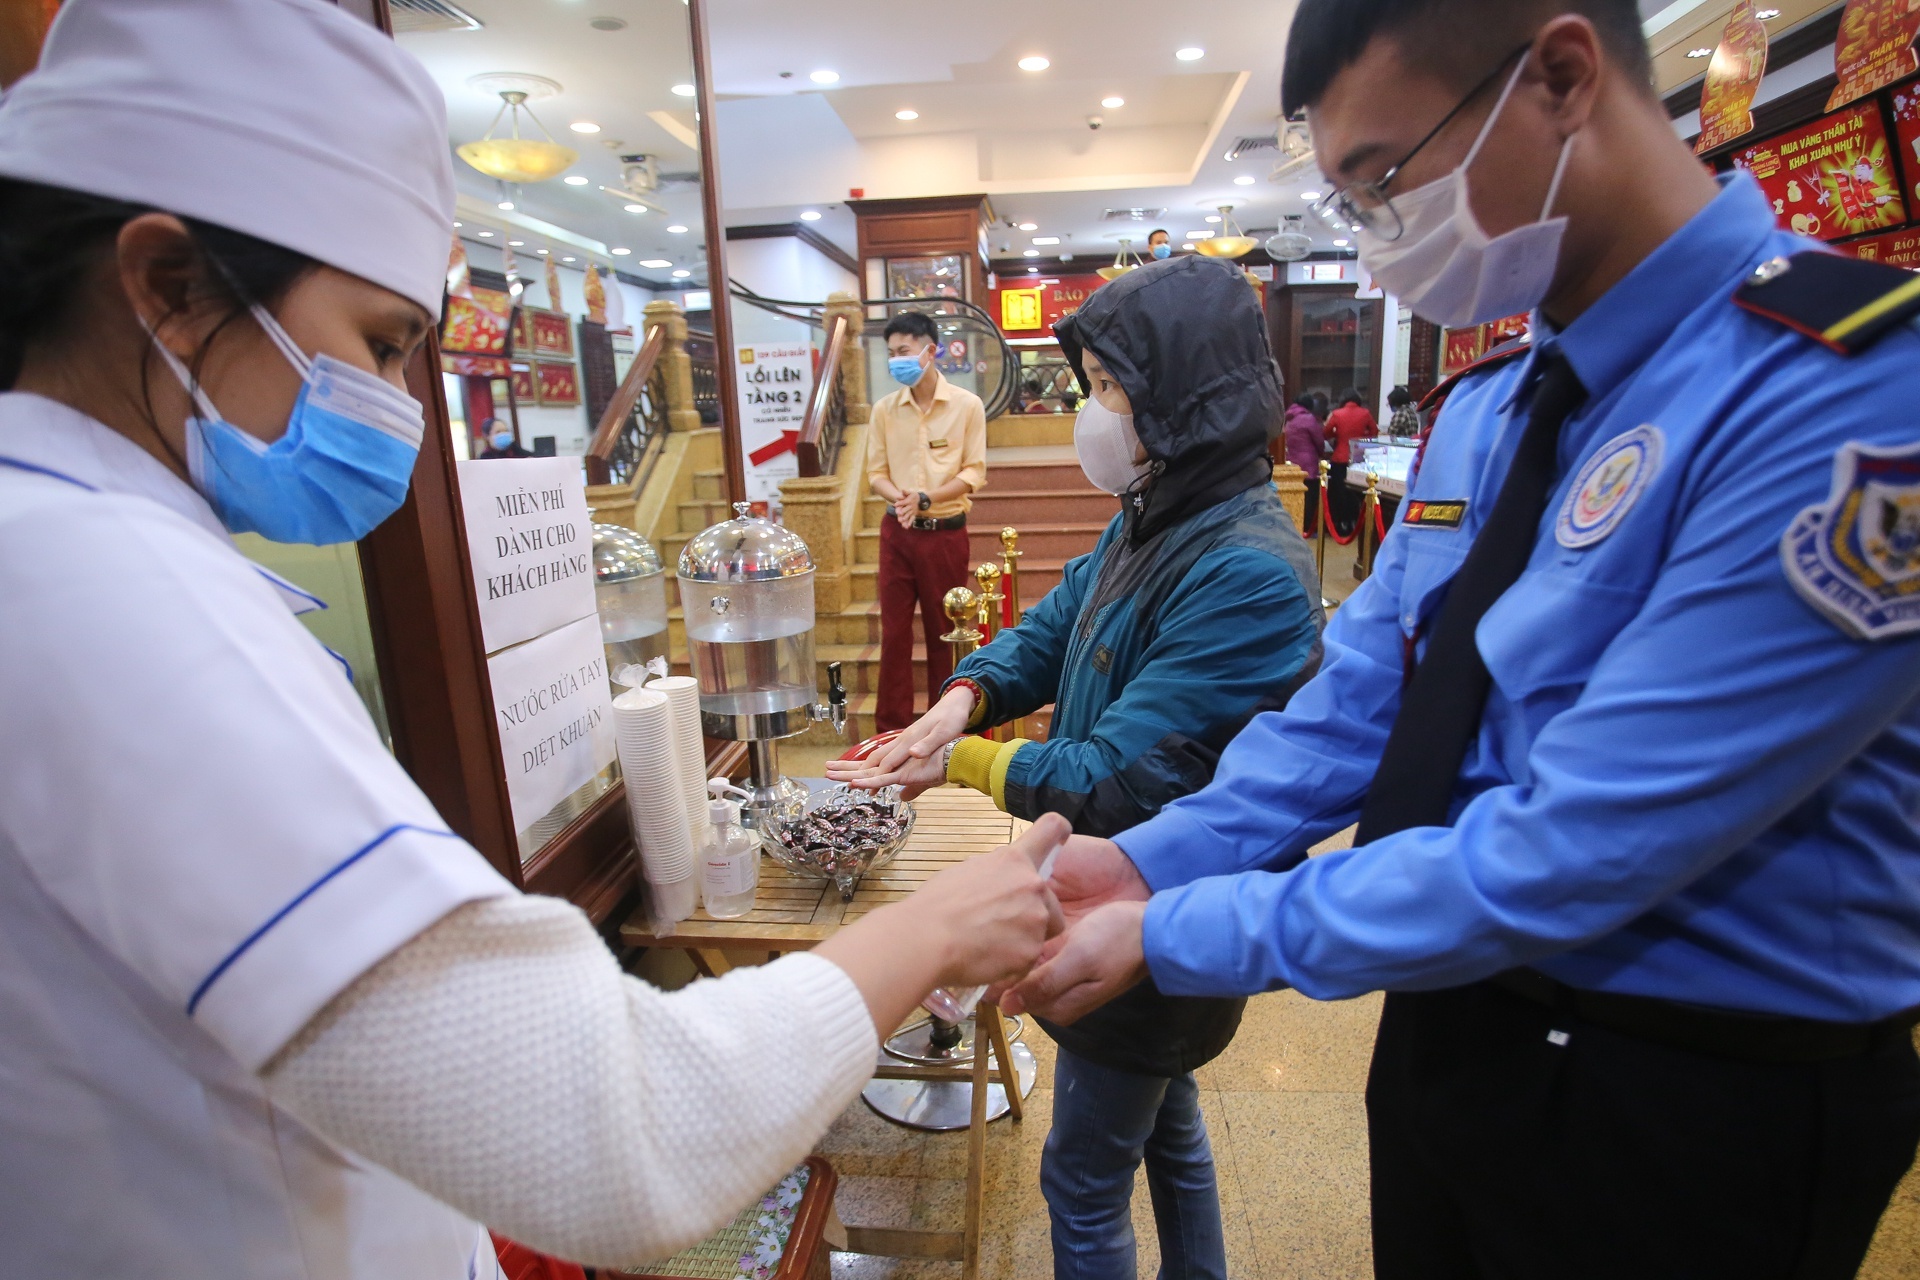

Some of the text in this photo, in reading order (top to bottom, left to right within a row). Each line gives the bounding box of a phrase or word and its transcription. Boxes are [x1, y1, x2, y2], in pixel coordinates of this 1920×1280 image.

[1780, 141, 1799, 156] MUA
[1799, 133, 1822, 149] VÀNG
[1847, 114, 1863, 132] TÀI
[1788, 153, 1808, 171] KHAI
[1809, 144, 1833, 162] XUÂN
[1834, 136, 1854, 153] NHƯ
[745, 364, 801, 383] LỐI LÊN
[793, 390, 802, 403] 2
[495, 483, 565, 518] MIỄN PHÍ
[495, 522, 576, 558] DÀNH CHO
[486, 553, 587, 600] KHÁCH HÀNG
[500, 657, 602, 731] NƯỚC RỬA TAY
[522, 735, 556, 774] DIỆT
